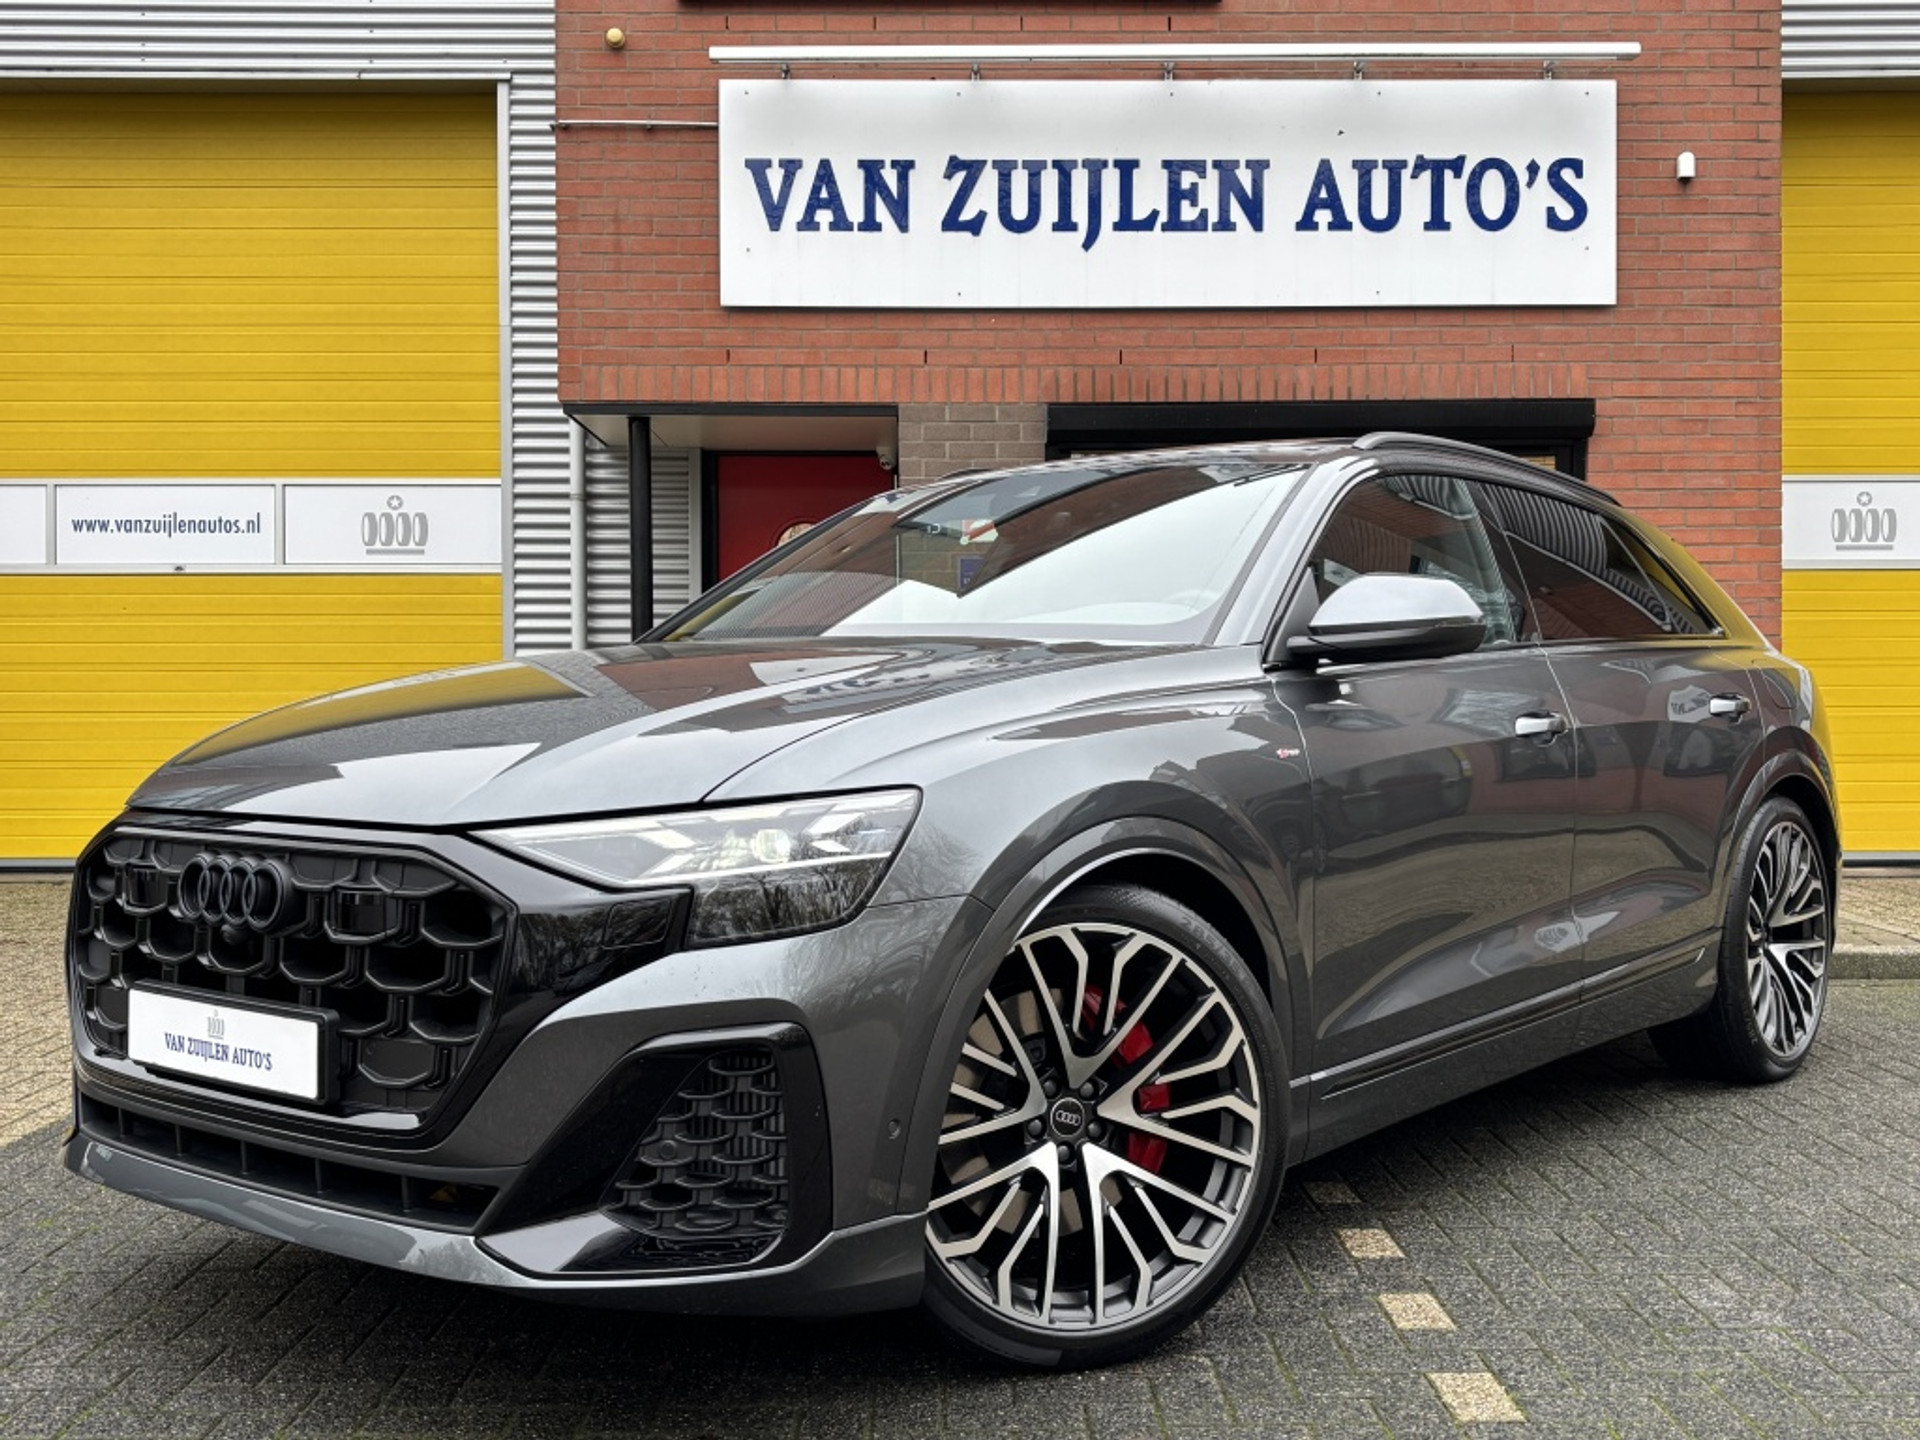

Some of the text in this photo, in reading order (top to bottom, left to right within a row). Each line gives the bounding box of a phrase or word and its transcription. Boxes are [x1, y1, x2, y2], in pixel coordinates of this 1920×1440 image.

[745, 154, 1587, 252] VAN ZUIJLEN AUTO'S
[71, 512, 261, 538] www.vanzuijlenautos.nl
[164, 1032, 273, 1071] VAN ZUIJLEN AUTO'S
